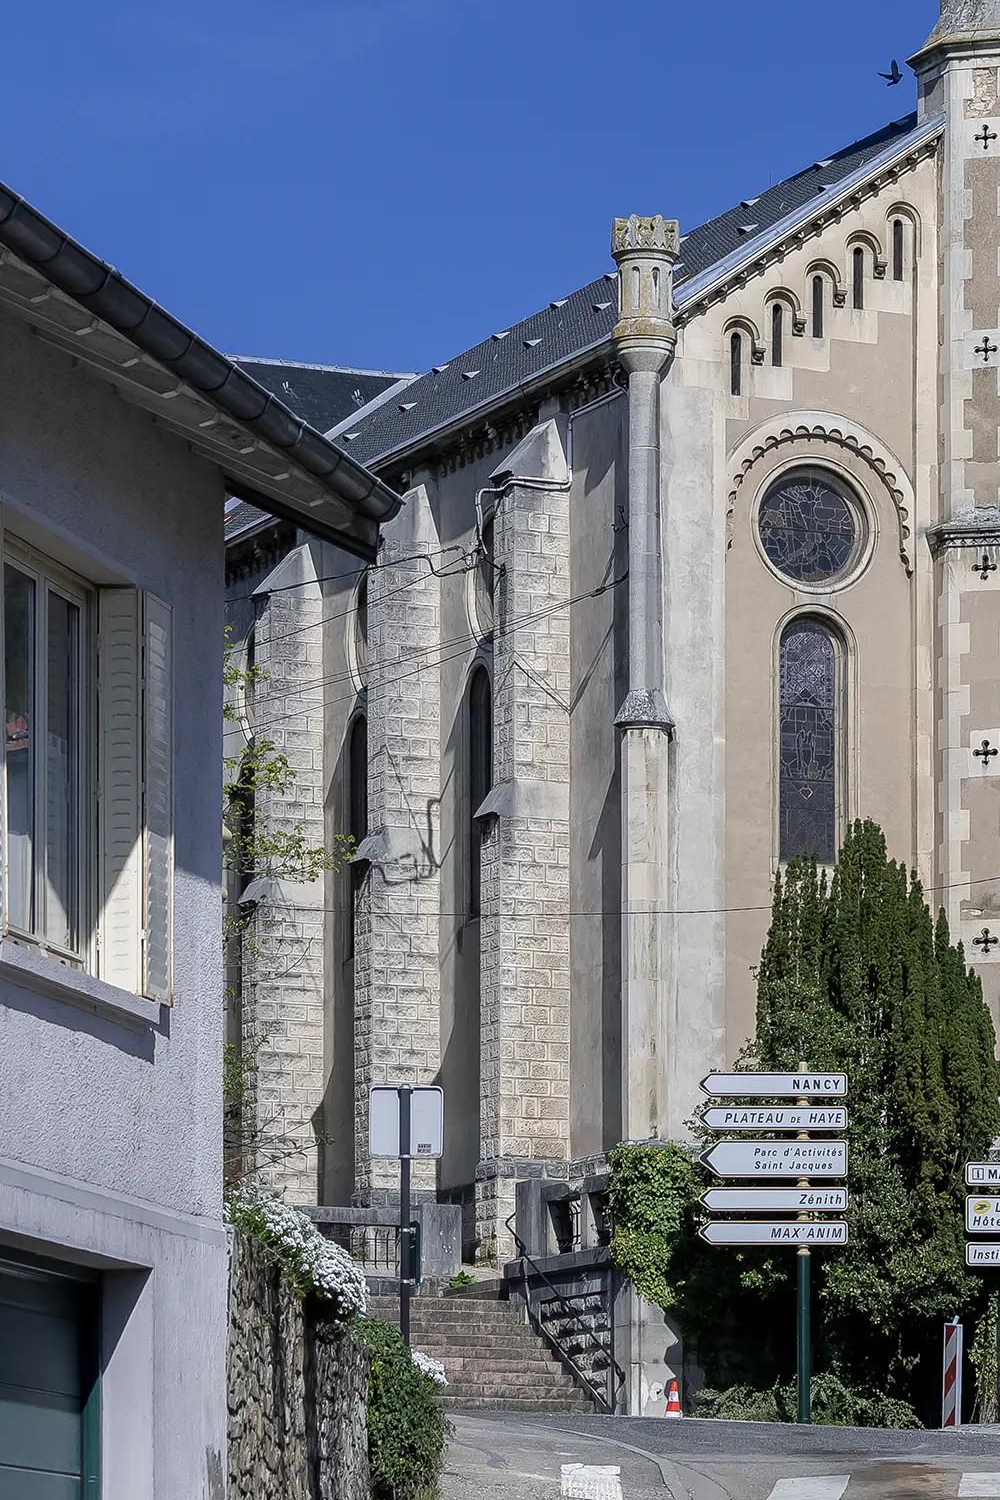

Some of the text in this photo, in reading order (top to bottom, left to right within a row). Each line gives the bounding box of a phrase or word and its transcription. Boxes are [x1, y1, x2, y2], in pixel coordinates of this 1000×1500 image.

[792, 1079, 841, 1090] NANCY
[724, 1112, 784, 1124] PLATEAU
[809, 1112, 843, 1124] HAYE
[754, 1147, 843, 1157] Parc d'Activités
[754, 1161, 833, 1172] Saint Jacques
[799, 1193, 843, 1205] Zénith
[770, 1227, 843, 1239] MAX'ANIM
